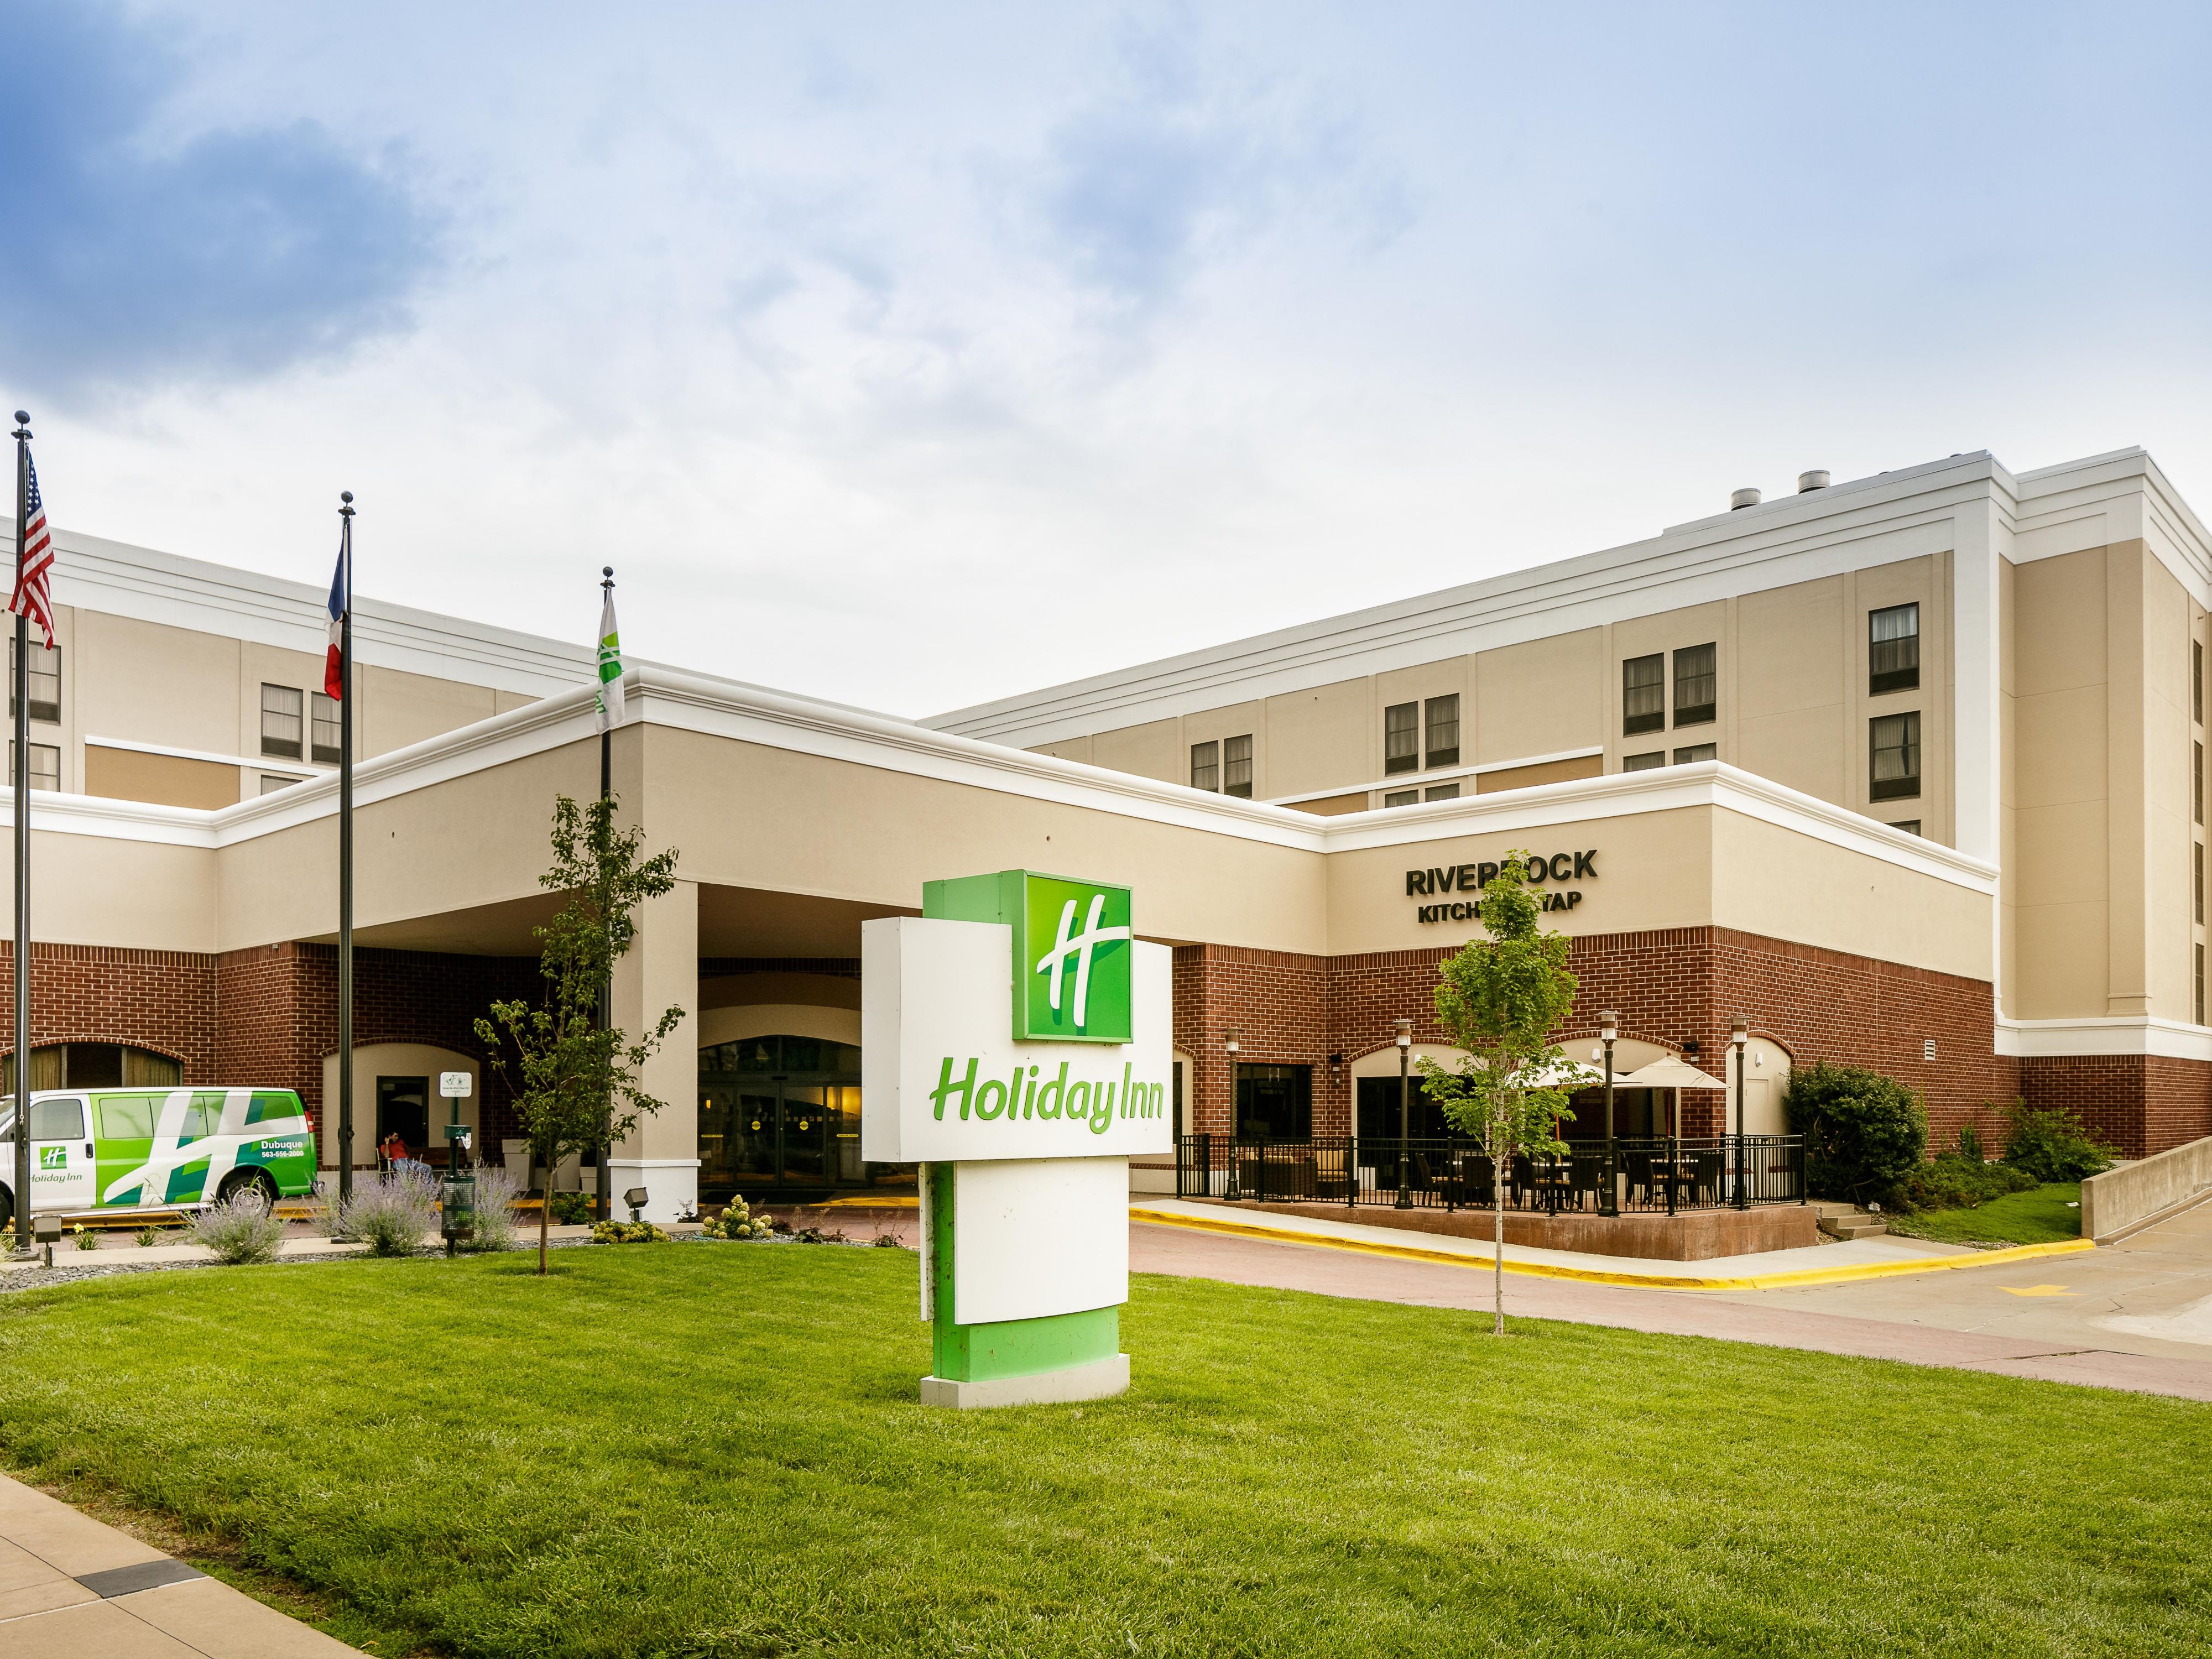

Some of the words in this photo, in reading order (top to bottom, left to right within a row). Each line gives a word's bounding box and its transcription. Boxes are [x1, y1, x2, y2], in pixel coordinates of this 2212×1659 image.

[1418, 900, 1484, 923] KITCH
[1542, 891, 1582, 912] TAP
[930, 1057, 1115, 1134] Holiday
[1120, 1062, 1164, 1119] Inn
[261, 1141, 303, 1150] Dubuque
